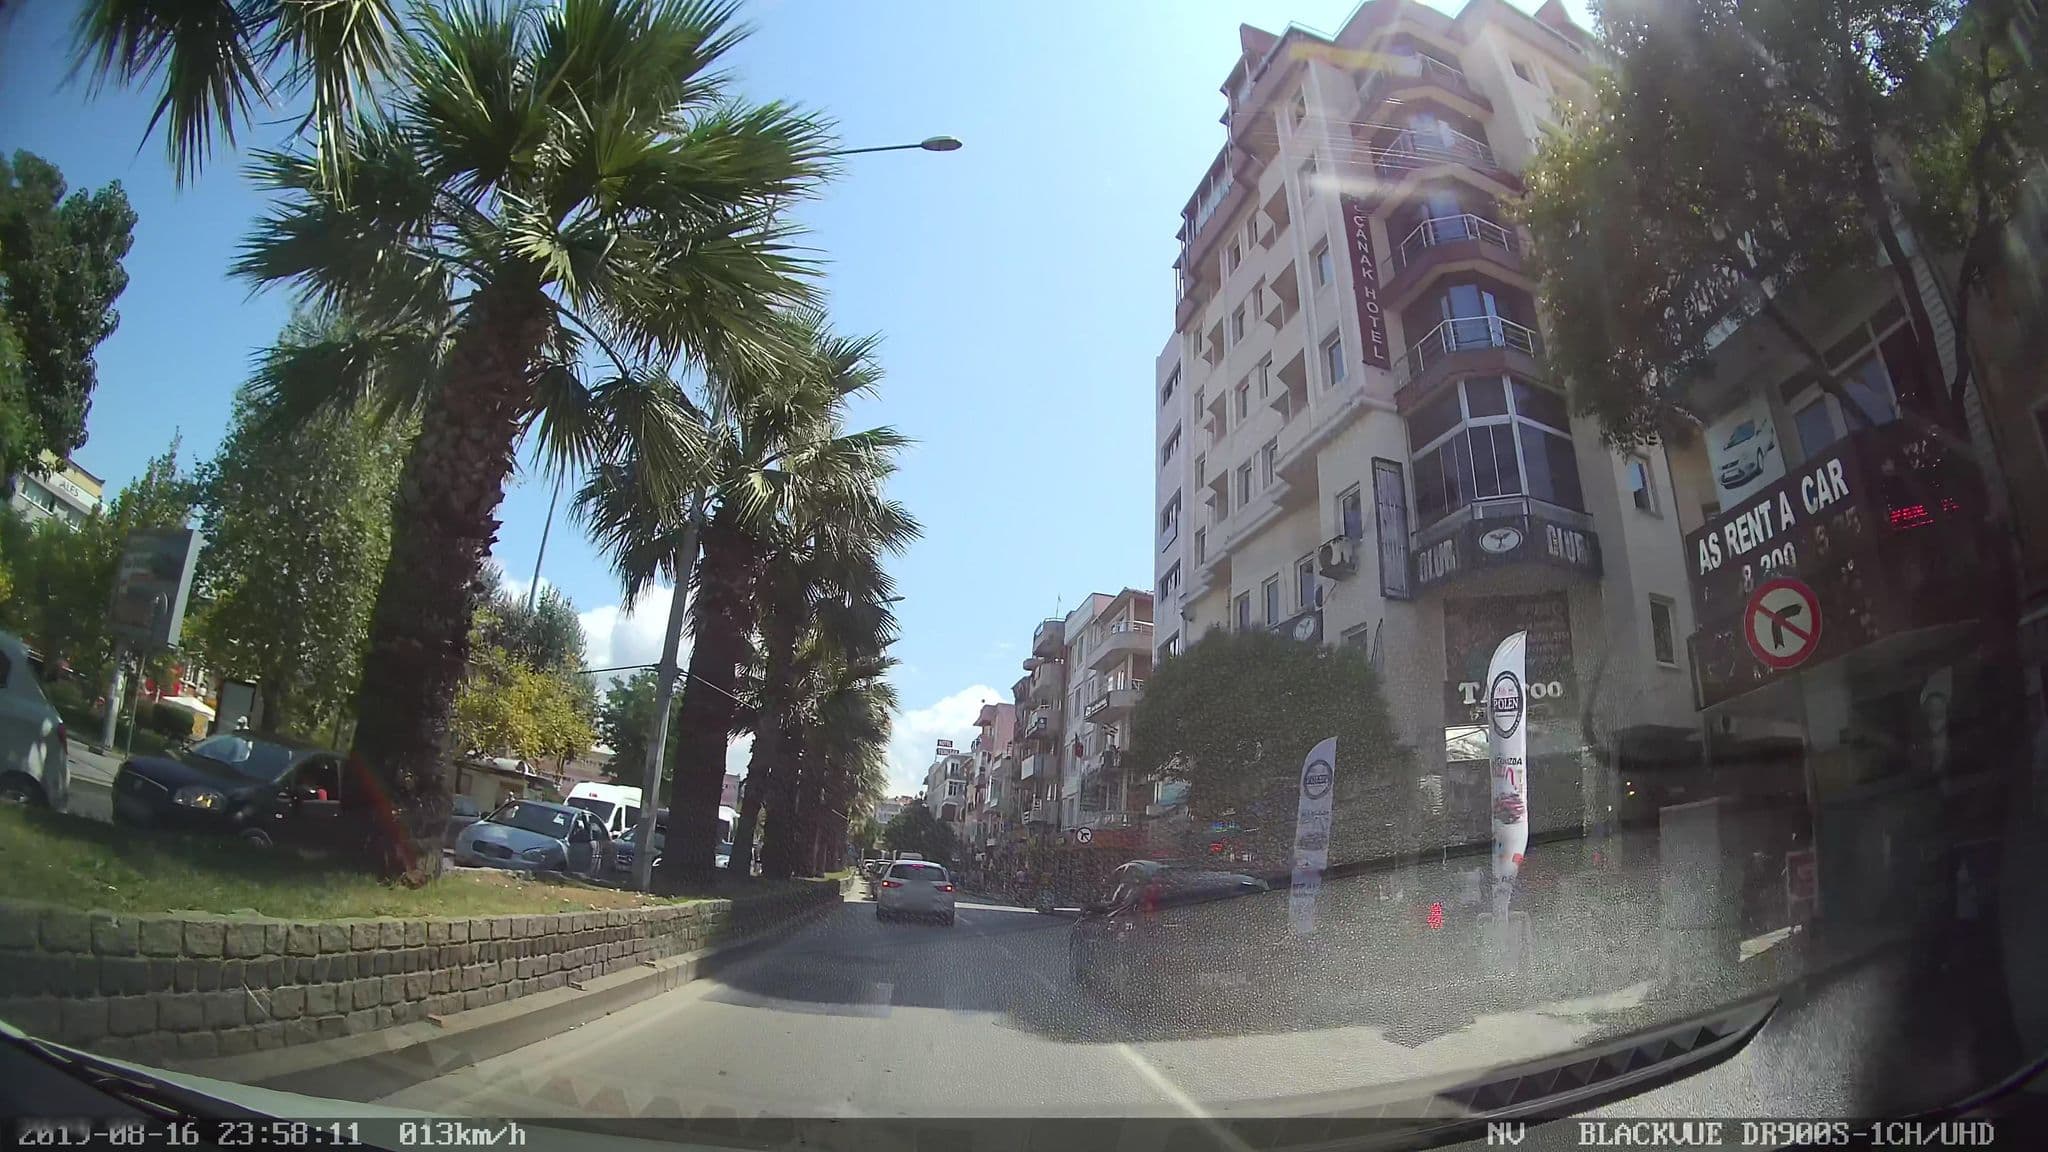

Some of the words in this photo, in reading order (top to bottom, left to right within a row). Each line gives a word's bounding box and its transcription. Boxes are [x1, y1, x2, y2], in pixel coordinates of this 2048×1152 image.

[1364, 286, 1384, 360] HOTEL
[1699, 531, 1722, 576] AS
[1724, 499, 1776, 558] RENT
[1779, 490, 1796, 532] A
[1801, 457, 1850, 515] CAR
[1493, 697, 1519, 710] POLEN
